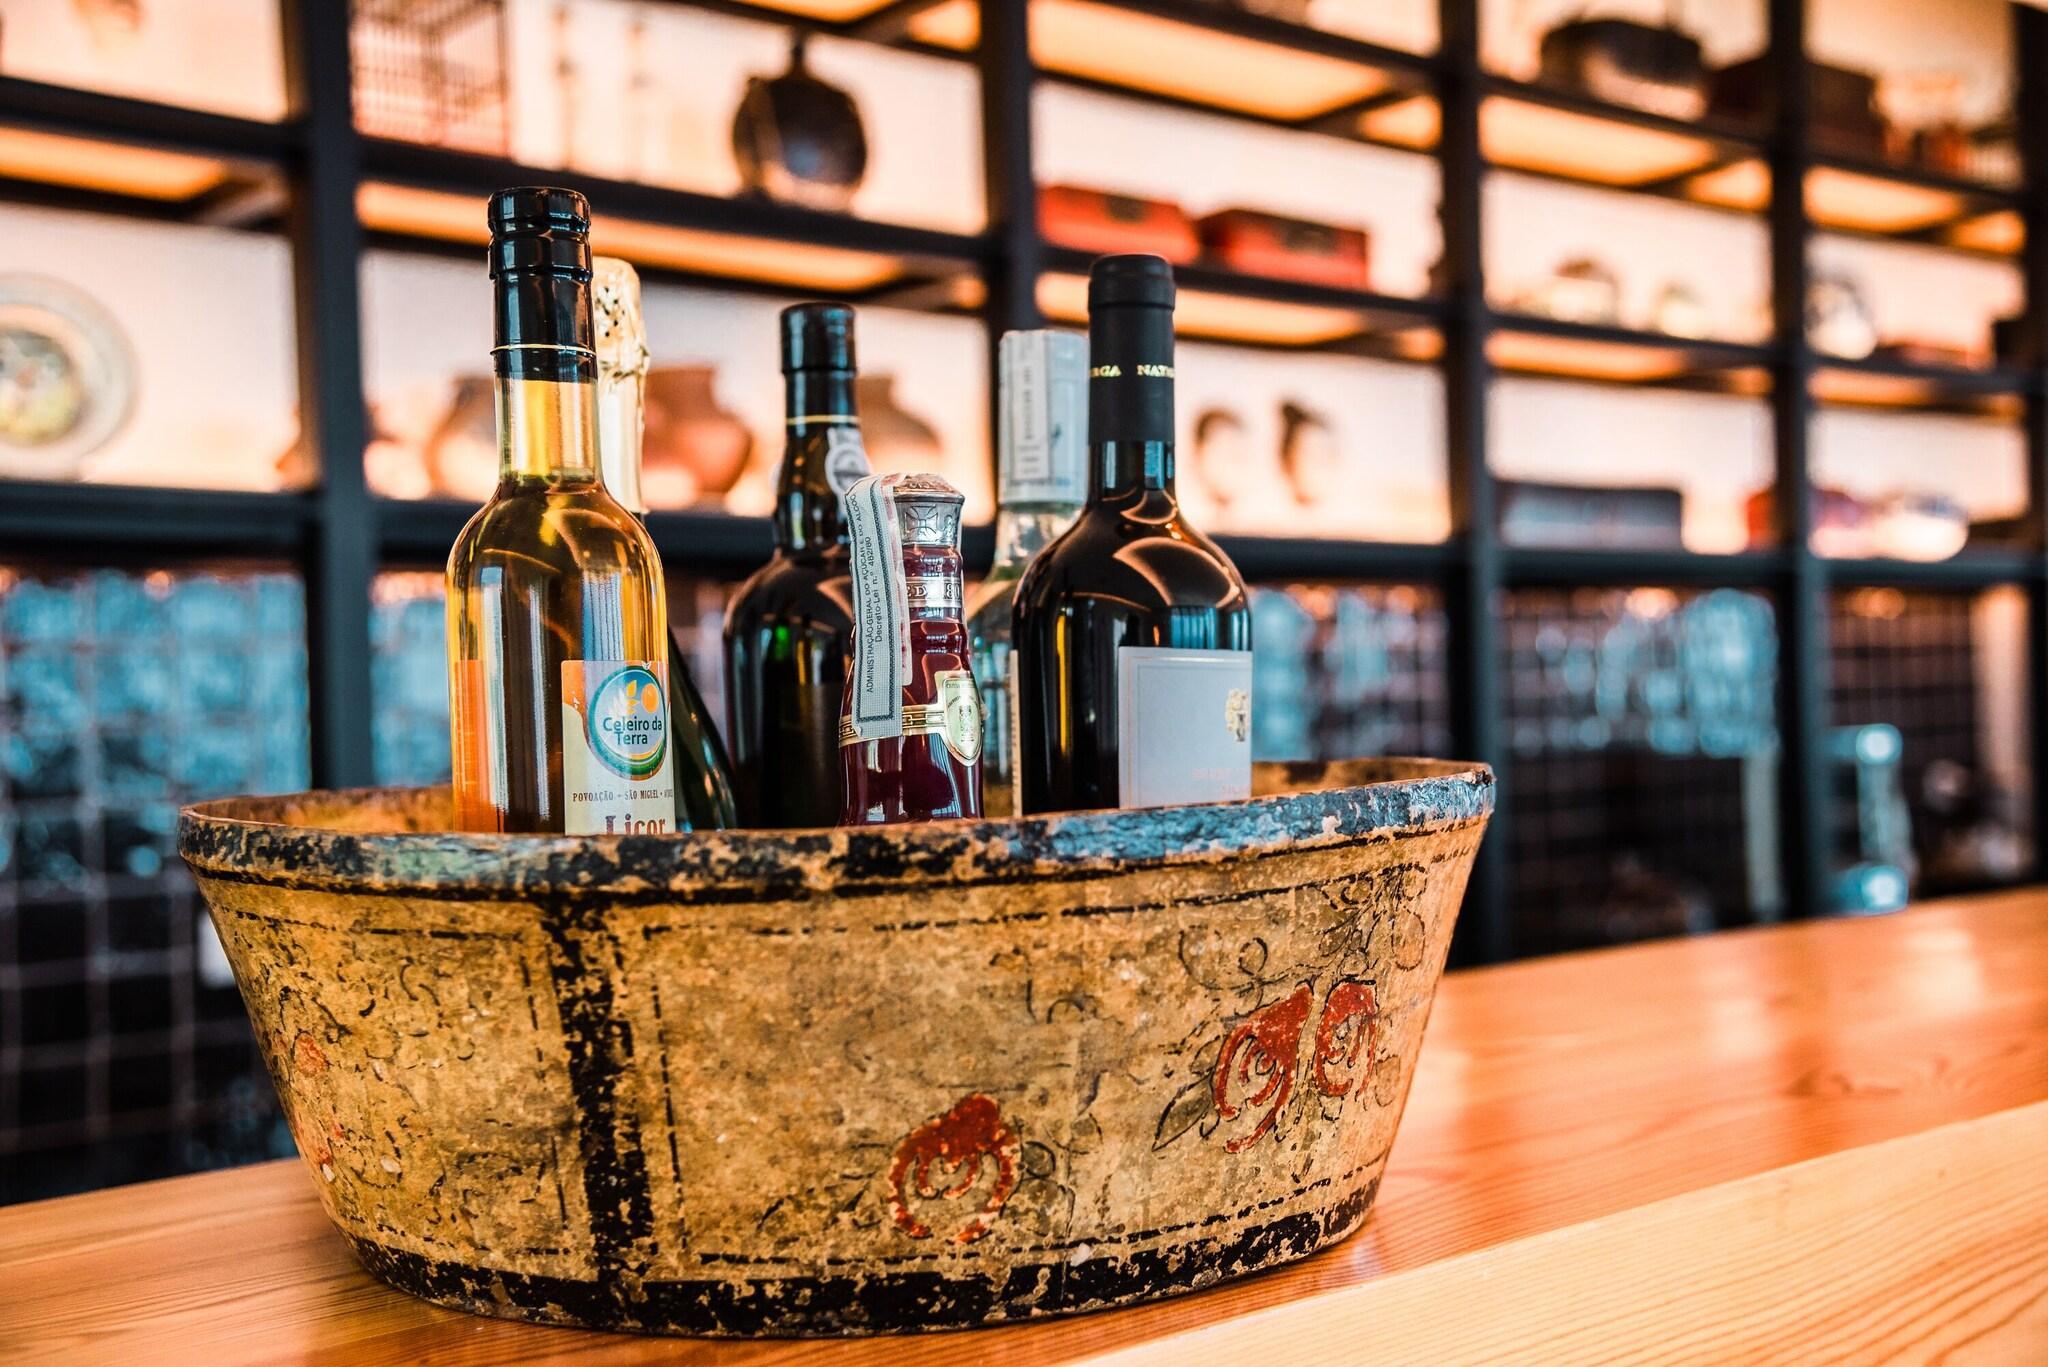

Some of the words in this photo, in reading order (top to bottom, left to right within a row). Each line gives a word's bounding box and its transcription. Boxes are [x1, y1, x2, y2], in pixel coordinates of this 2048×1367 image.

[864, 583, 871, 596] DO
[602, 715, 650, 731] Celeiro
[651, 715, 662, 731] da
[614, 731, 648, 746] Terra
[572, 790, 614, 802] POVOAÇÃO
[625, 788, 638, 800] SÃO
[639, 788, 659, 800] MIGUEL
